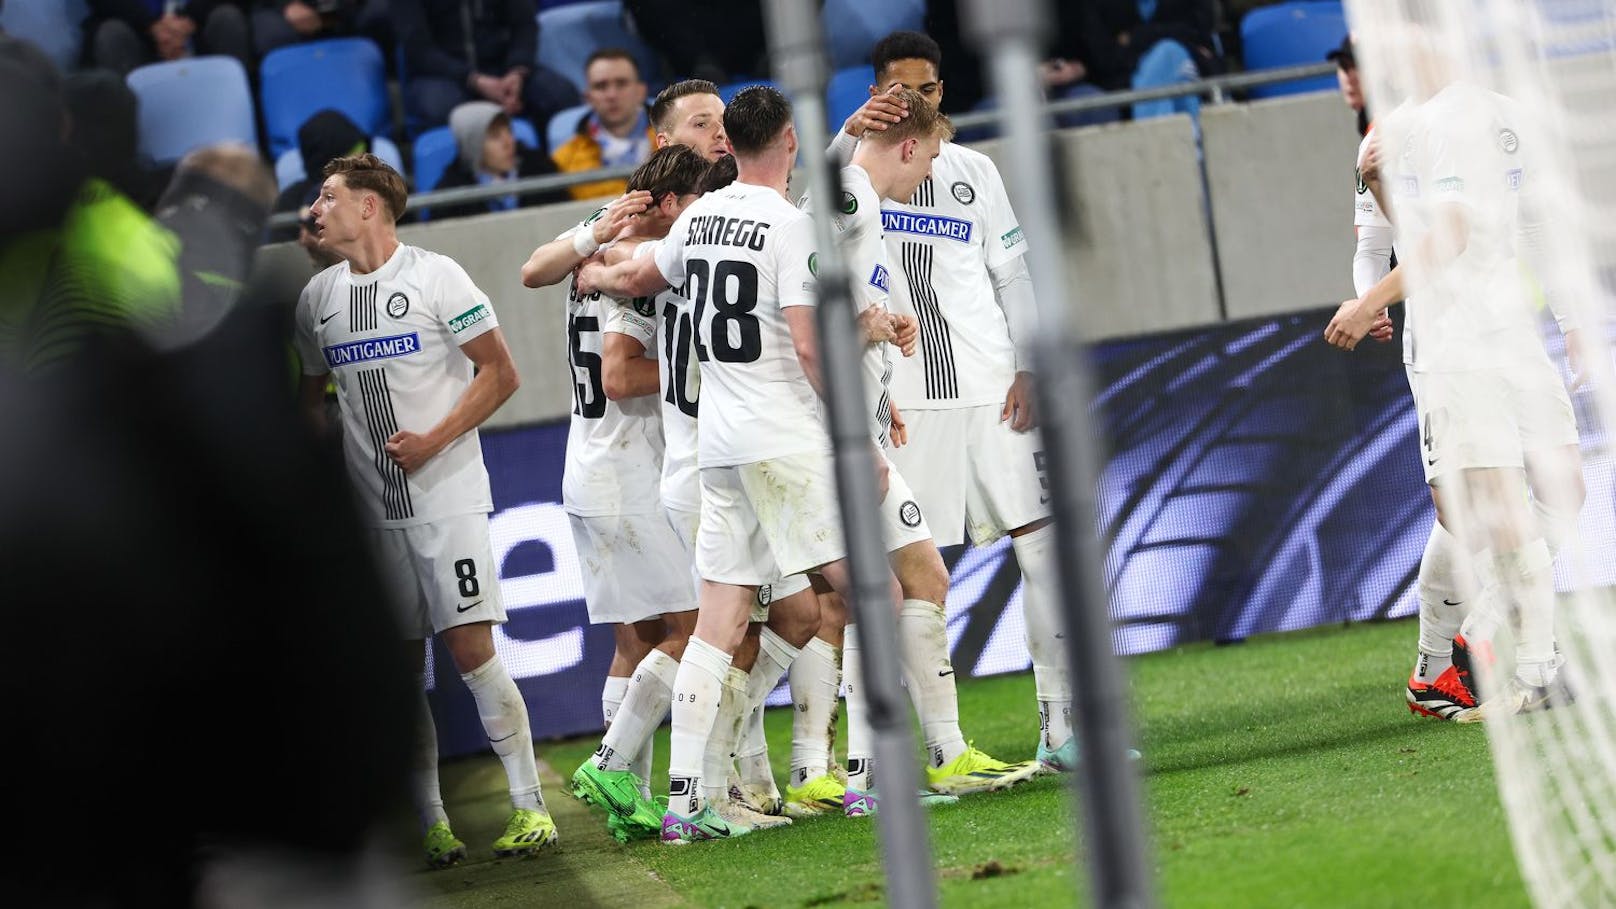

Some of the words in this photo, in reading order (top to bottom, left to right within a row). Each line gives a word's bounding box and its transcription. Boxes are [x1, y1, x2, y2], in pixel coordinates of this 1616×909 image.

[685, 215, 771, 252] SCHNEGG
[880, 213, 969, 240] UNTIGAMER
[686, 259, 761, 363] 28
[568, 312, 607, 418] 15
[663, 301, 700, 418] 10
[455, 559, 480, 597] 8
